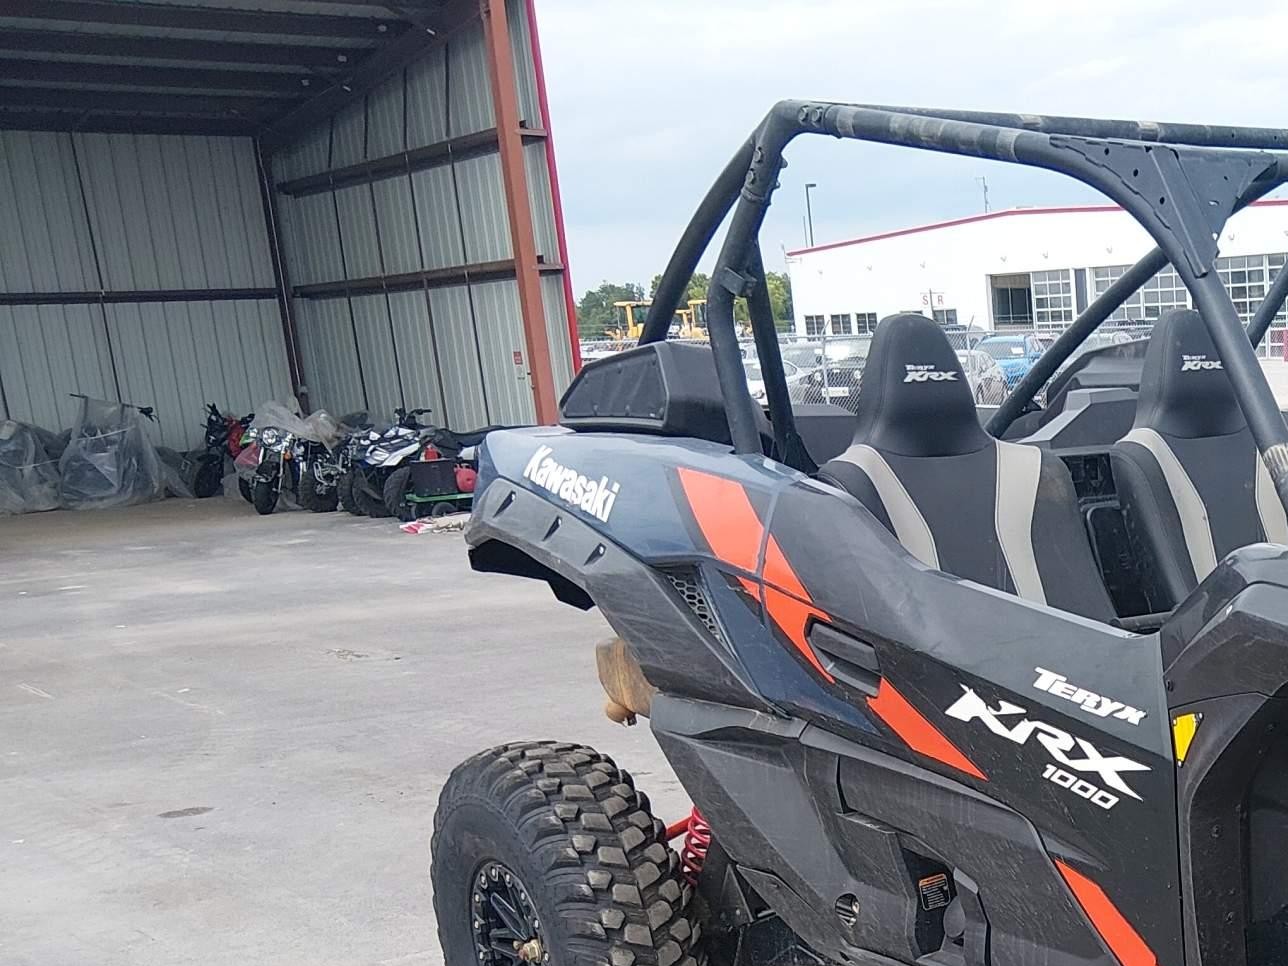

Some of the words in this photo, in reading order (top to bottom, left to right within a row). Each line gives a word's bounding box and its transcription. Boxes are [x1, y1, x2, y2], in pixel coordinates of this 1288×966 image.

[903, 371, 960, 383] KRX
[1181, 360, 1224, 371] KRX
[523, 444, 620, 523] Kawasaki
[944, 683, 1152, 802] KRX
[1041, 763, 1119, 810] 1000
